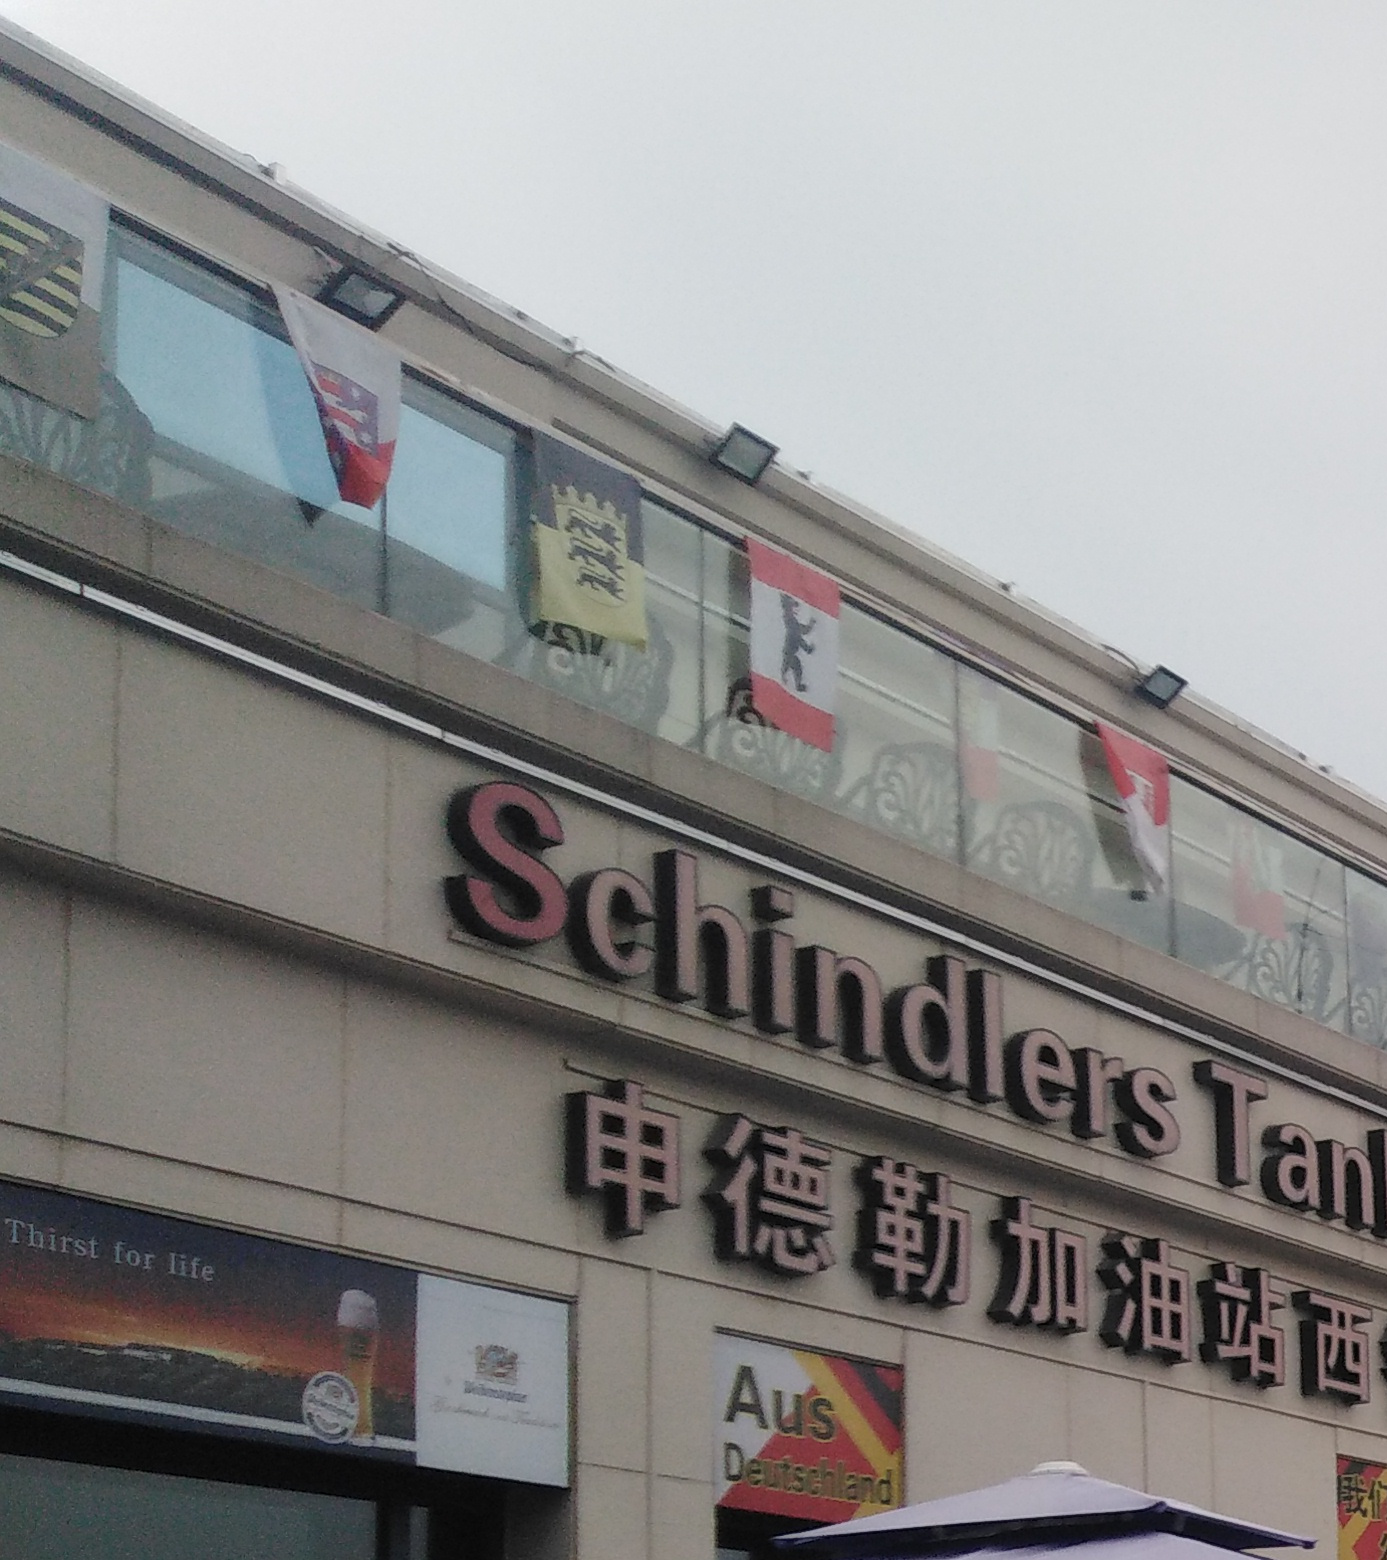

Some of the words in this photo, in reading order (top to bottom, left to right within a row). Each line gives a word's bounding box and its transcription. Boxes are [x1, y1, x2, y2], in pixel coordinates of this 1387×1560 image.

[446, 780, 1182, 1158] Schindlers
[5, 1217, 99, 1259] Thirst
[114, 1240, 155, 1270] for
[168, 1251, 215, 1282] life
[723, 1364, 838, 1442] Aus
